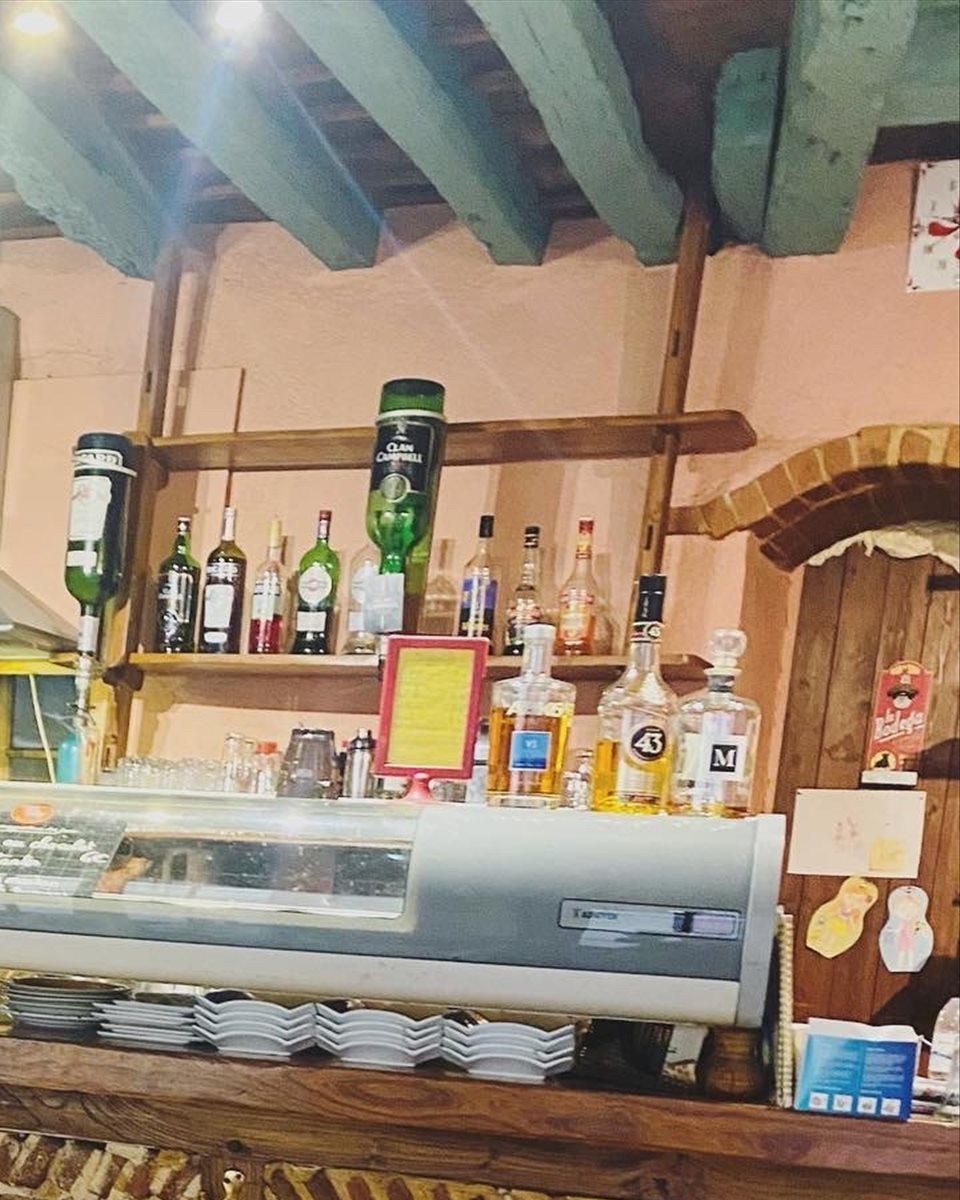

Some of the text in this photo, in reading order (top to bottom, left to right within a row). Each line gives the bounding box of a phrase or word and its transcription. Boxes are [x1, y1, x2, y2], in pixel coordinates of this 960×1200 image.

[385, 442, 415, 453] CLAN
[634, 731, 664, 755] 43
[713, 747, 737, 768] M
